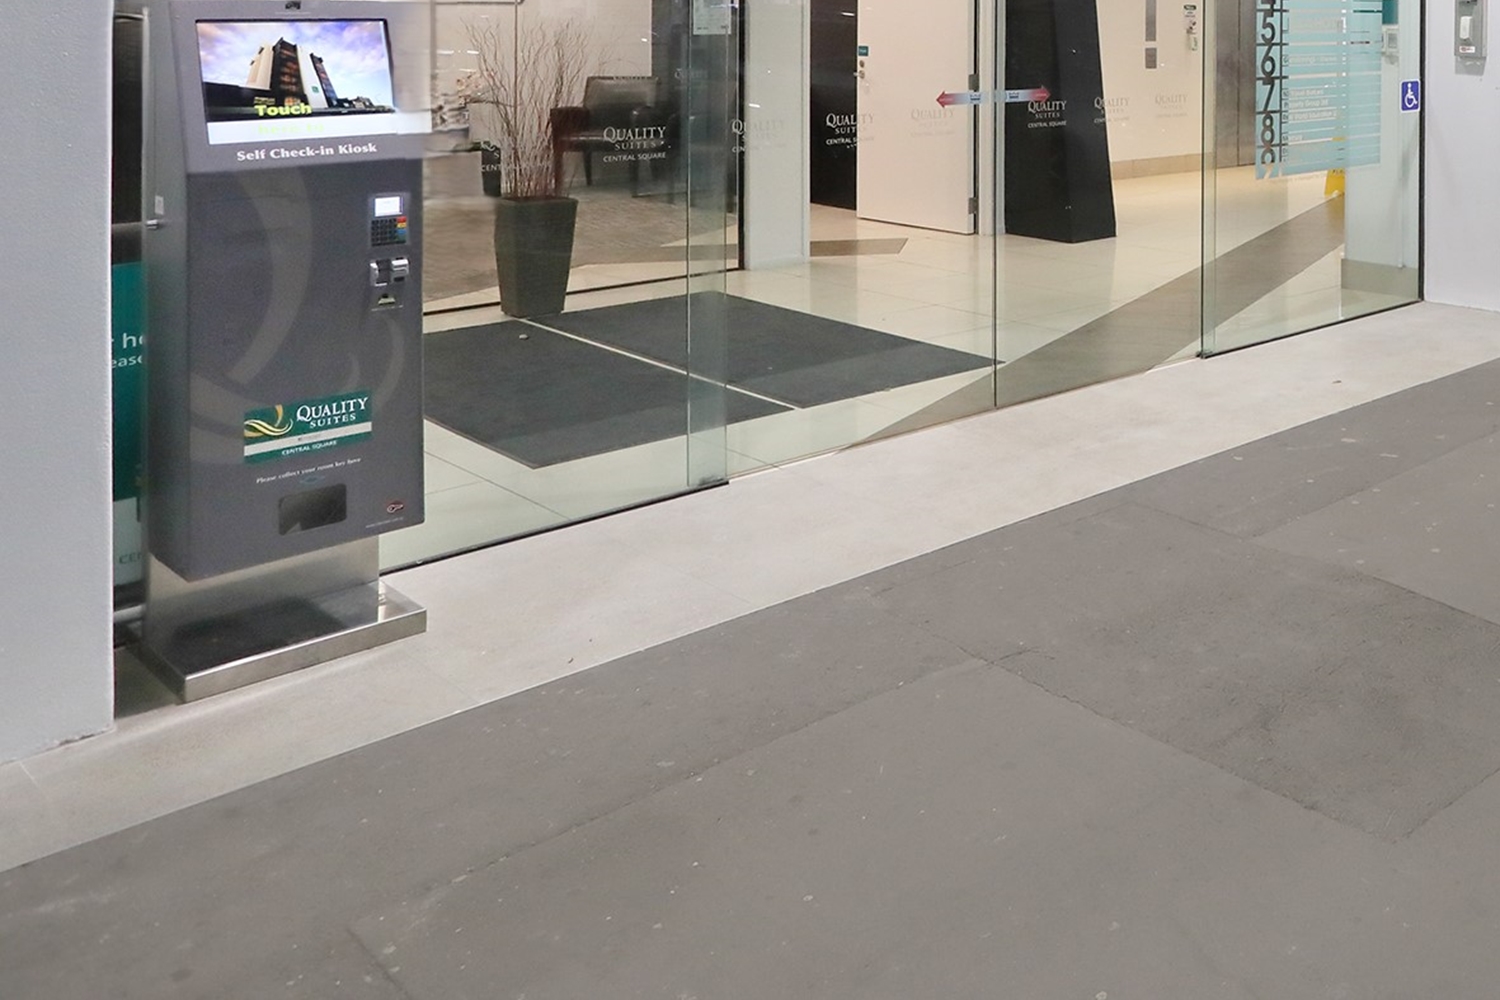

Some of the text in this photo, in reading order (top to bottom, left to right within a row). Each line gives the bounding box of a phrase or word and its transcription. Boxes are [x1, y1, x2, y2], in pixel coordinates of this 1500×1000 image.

[1261, 11, 1276, 45] 5
[1261, 45, 1276, 77] 6
[1262, 79, 1275, 111] 7
[254, 102, 313, 118] Touch
[1028, 99, 1067, 114] QUALITY
[1035, 111, 1060, 119] SUITES
[603, 126, 667, 143] QUALITY
[1261, 113, 1275, 145] 8
[236, 143, 377, 161] Self Check-in Kiosk
[615, 140, 657, 150] SUITES
[603, 151, 667, 162] CENTRAL SQUARE
[296, 397, 369, 422] QUALITY
[309, 414, 357, 429] SUITES
[281, 440, 338, 456] CENTRAL SQUARE
[256, 475, 277, 484] Please
